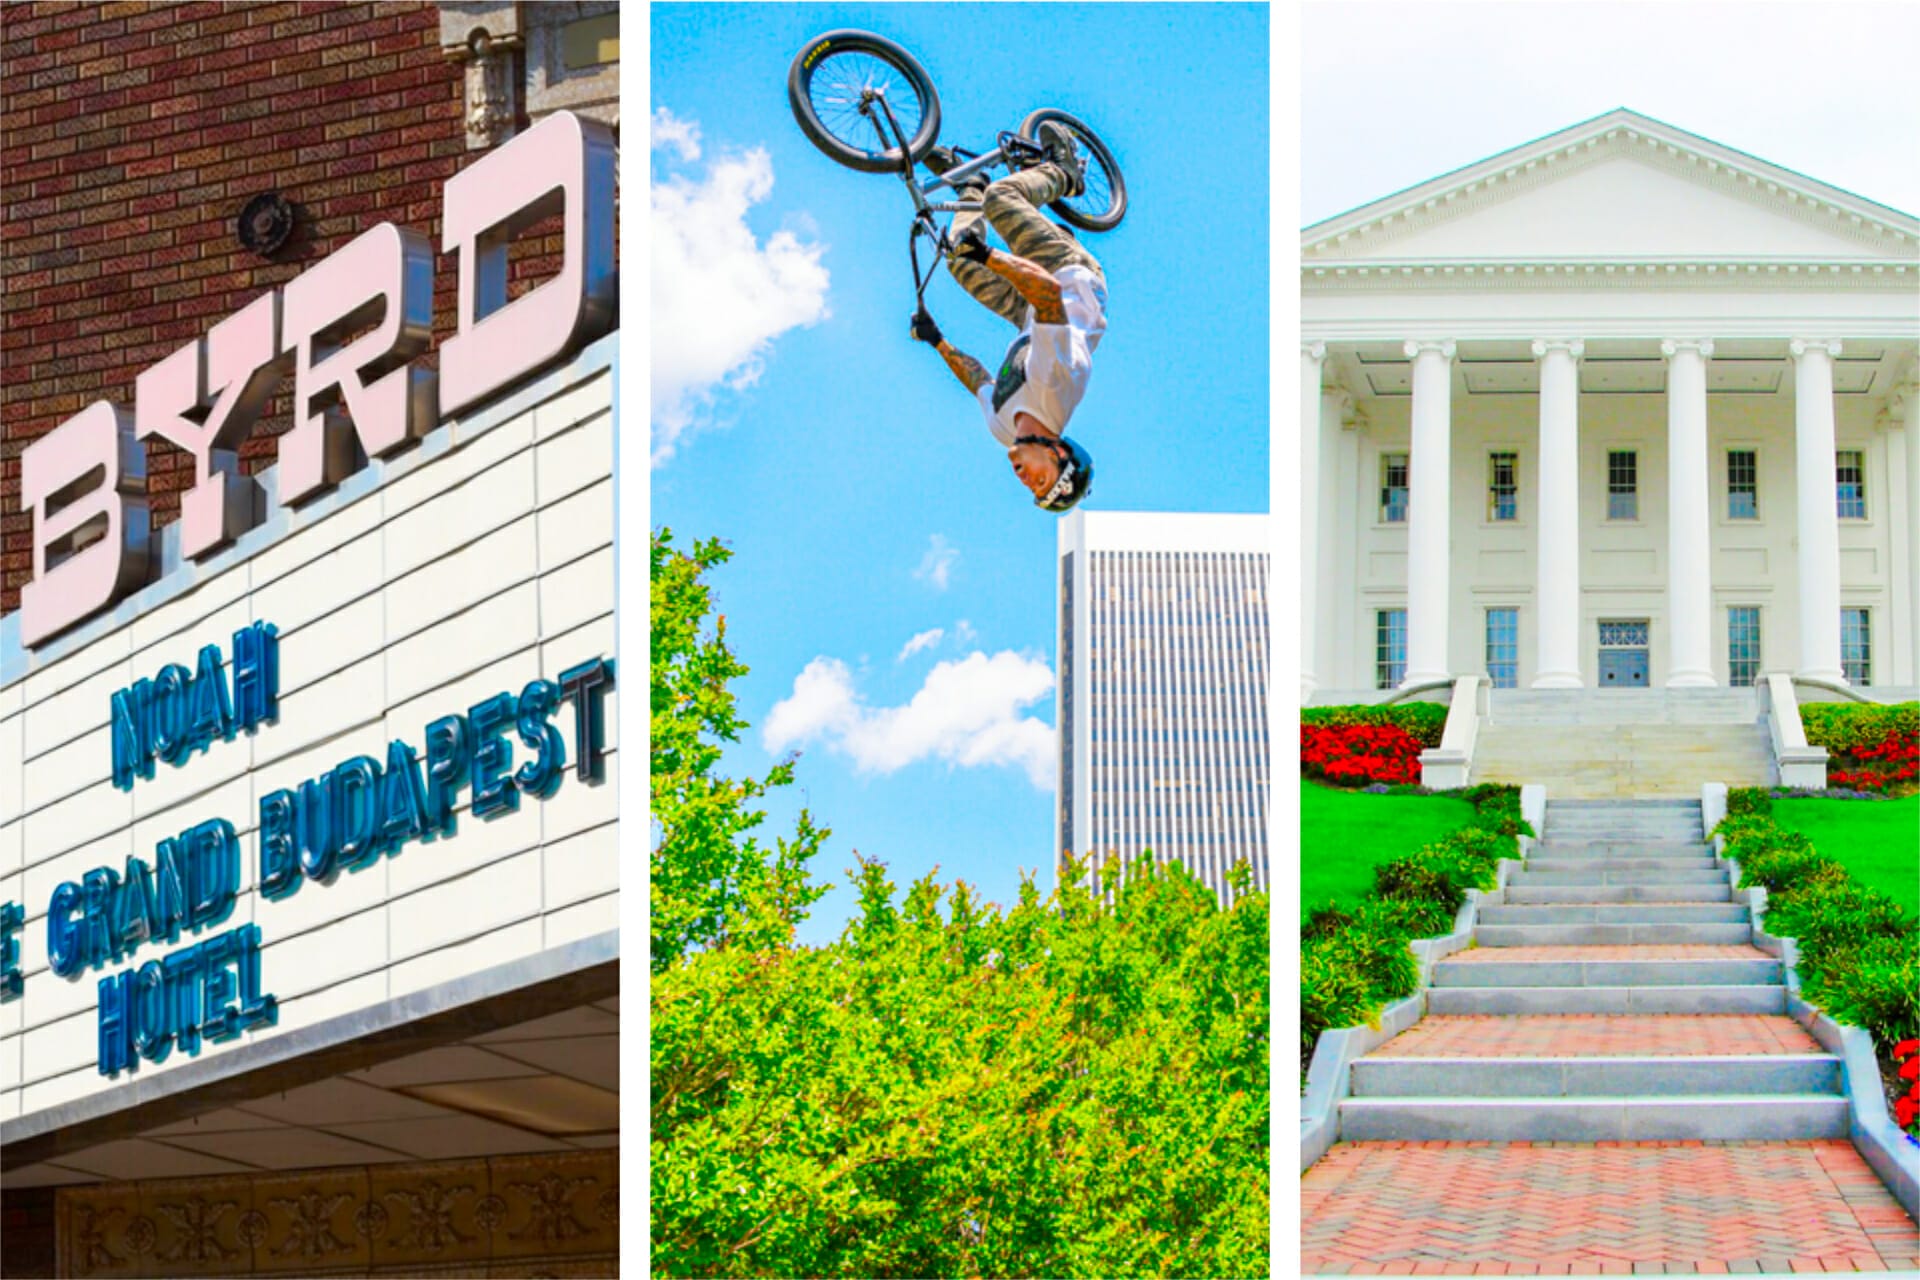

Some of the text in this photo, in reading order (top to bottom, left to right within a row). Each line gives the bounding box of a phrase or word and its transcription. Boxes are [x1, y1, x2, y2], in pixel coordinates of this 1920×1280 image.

[20, 109, 606, 648] BYRD
[47, 817, 241, 982] GRAND
[259, 653, 617, 901] BUDAPEST
[110, 620, 280, 792] NOAH
[97, 922, 279, 1078] HOTEL
